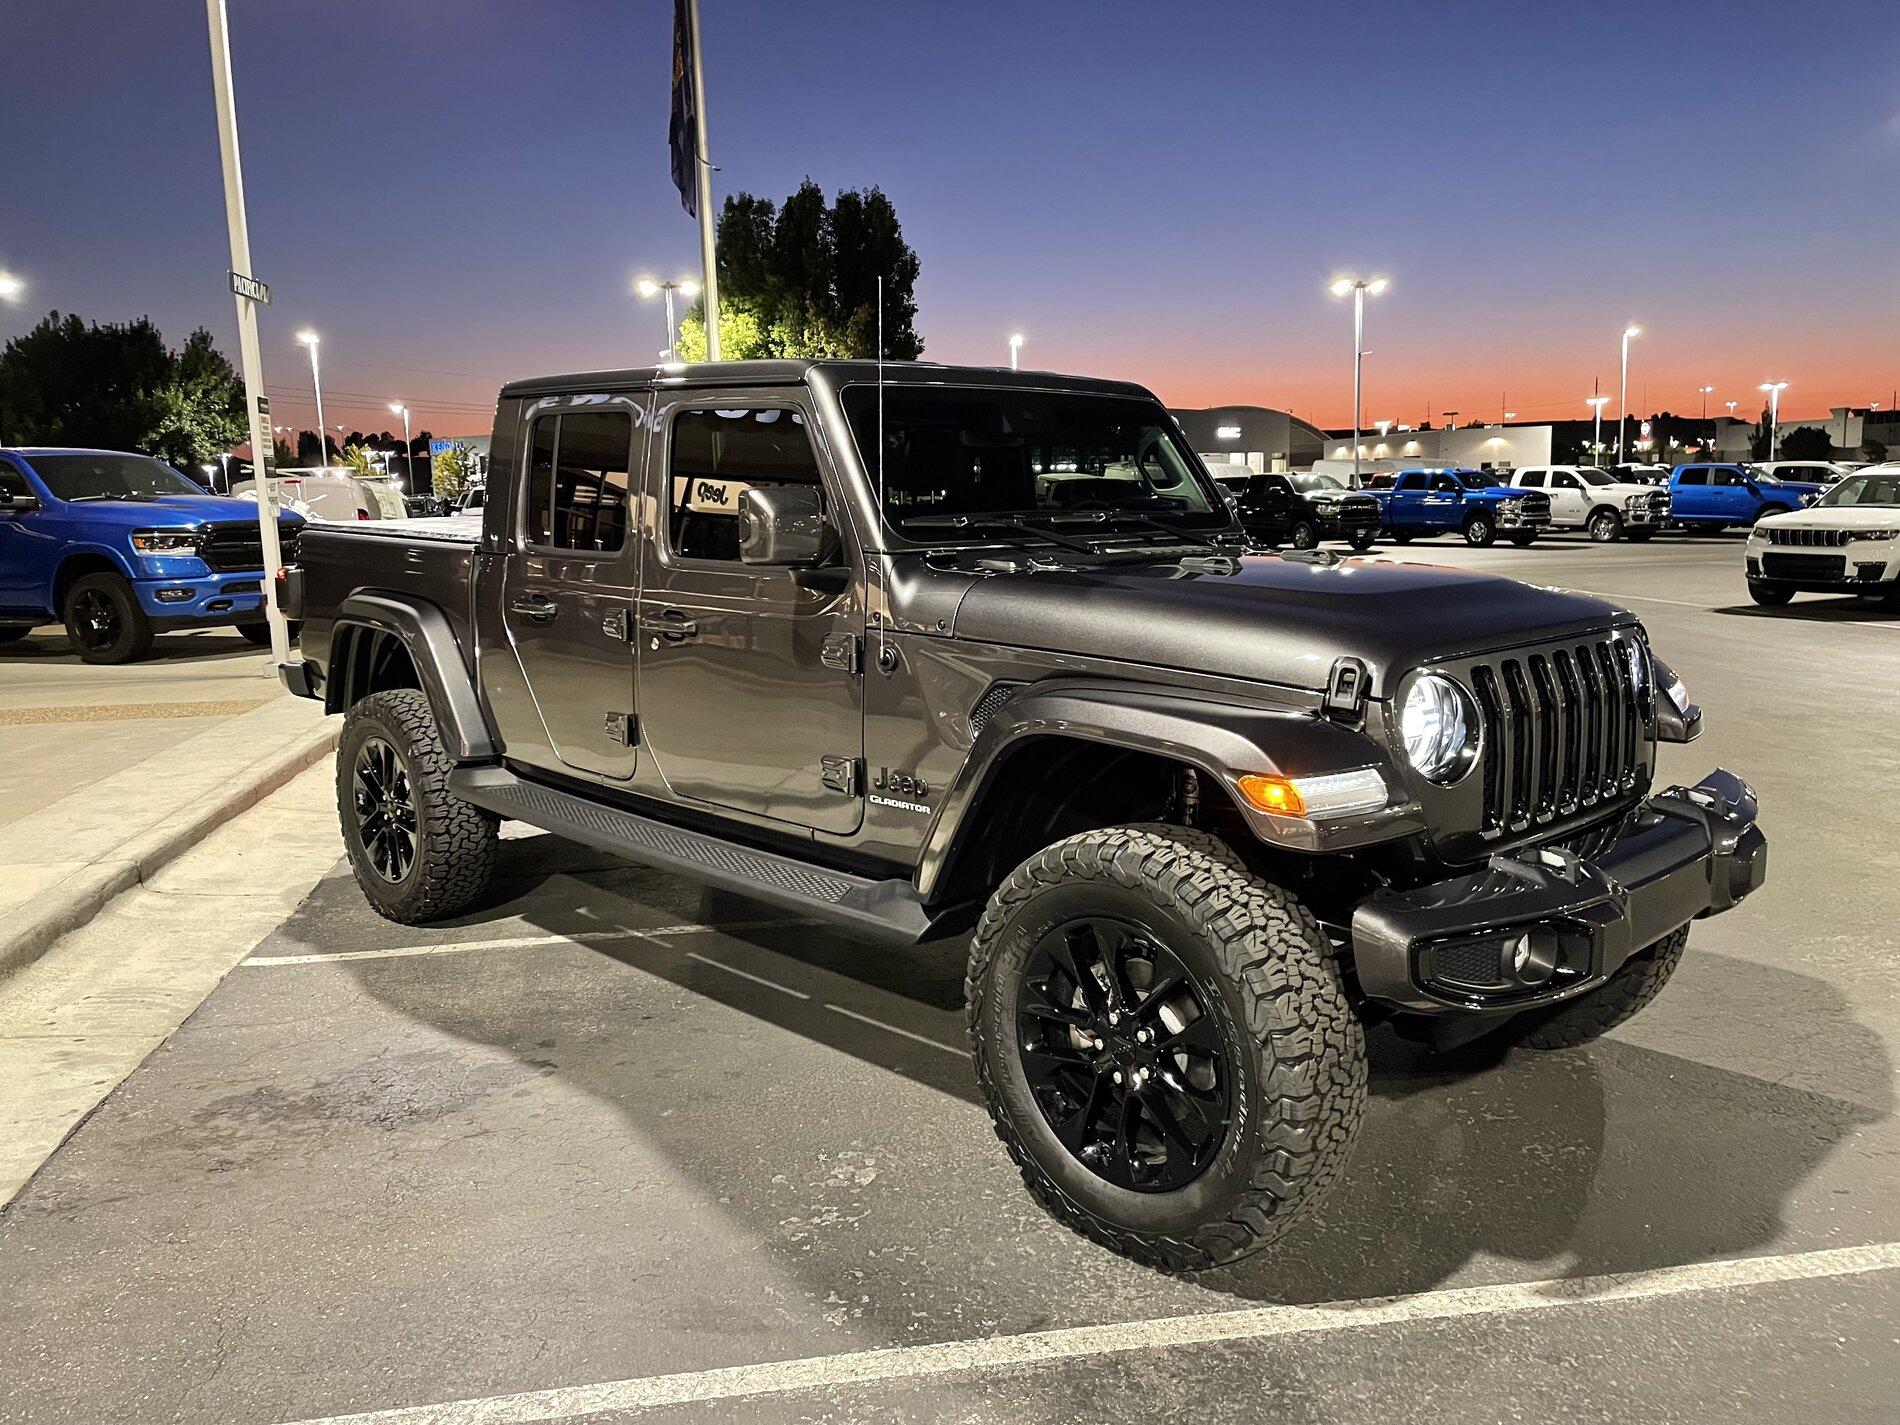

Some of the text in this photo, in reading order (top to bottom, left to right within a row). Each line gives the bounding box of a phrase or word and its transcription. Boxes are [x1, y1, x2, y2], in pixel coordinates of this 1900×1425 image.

[431, 441, 465, 451] KENDLL
[873, 767, 929, 799] Jeep
[869, 794, 931, 815] GLADIATOR
